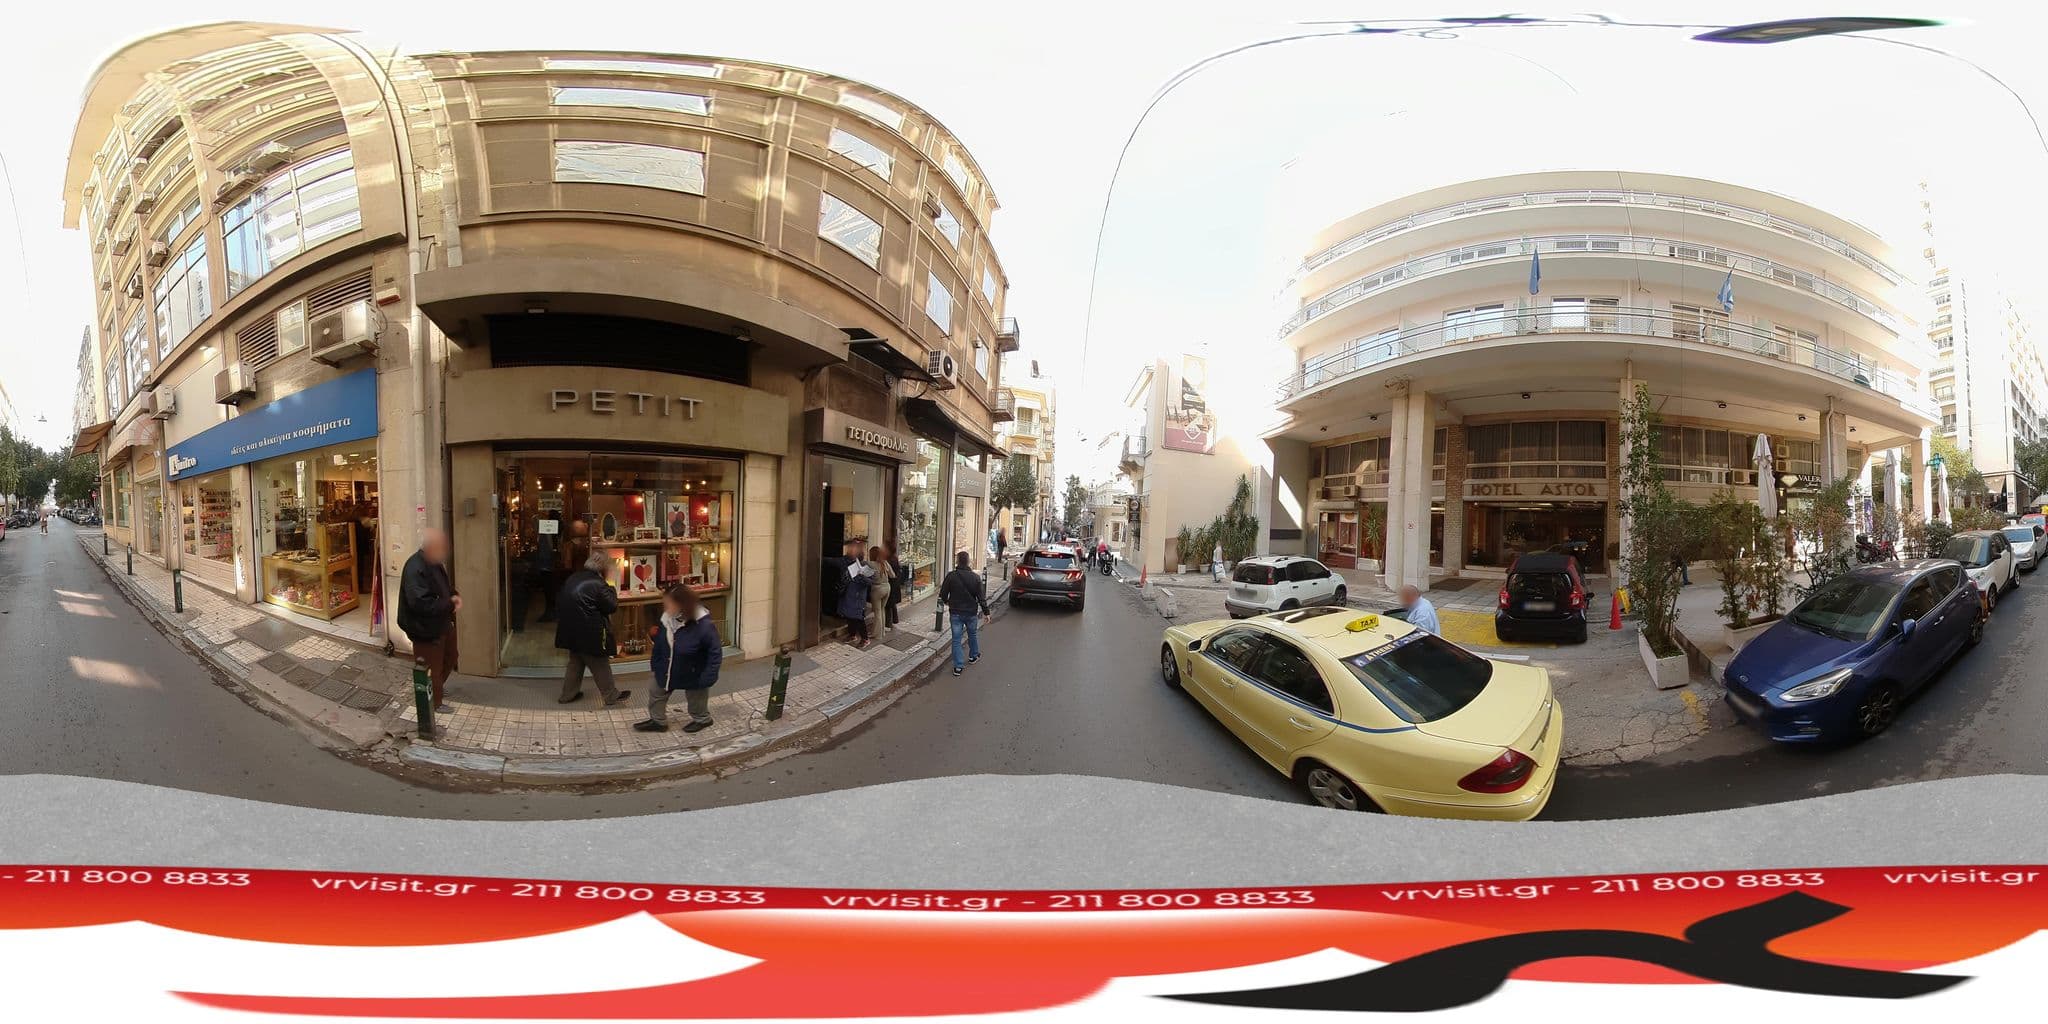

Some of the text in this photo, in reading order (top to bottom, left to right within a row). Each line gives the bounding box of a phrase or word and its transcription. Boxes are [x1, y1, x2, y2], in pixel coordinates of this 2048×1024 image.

[551, 389, 704, 419] PETIT
[1471, 483, 1597, 497] HOTEL ASTOR
[1360, 617, 1377, 629] TAXI
